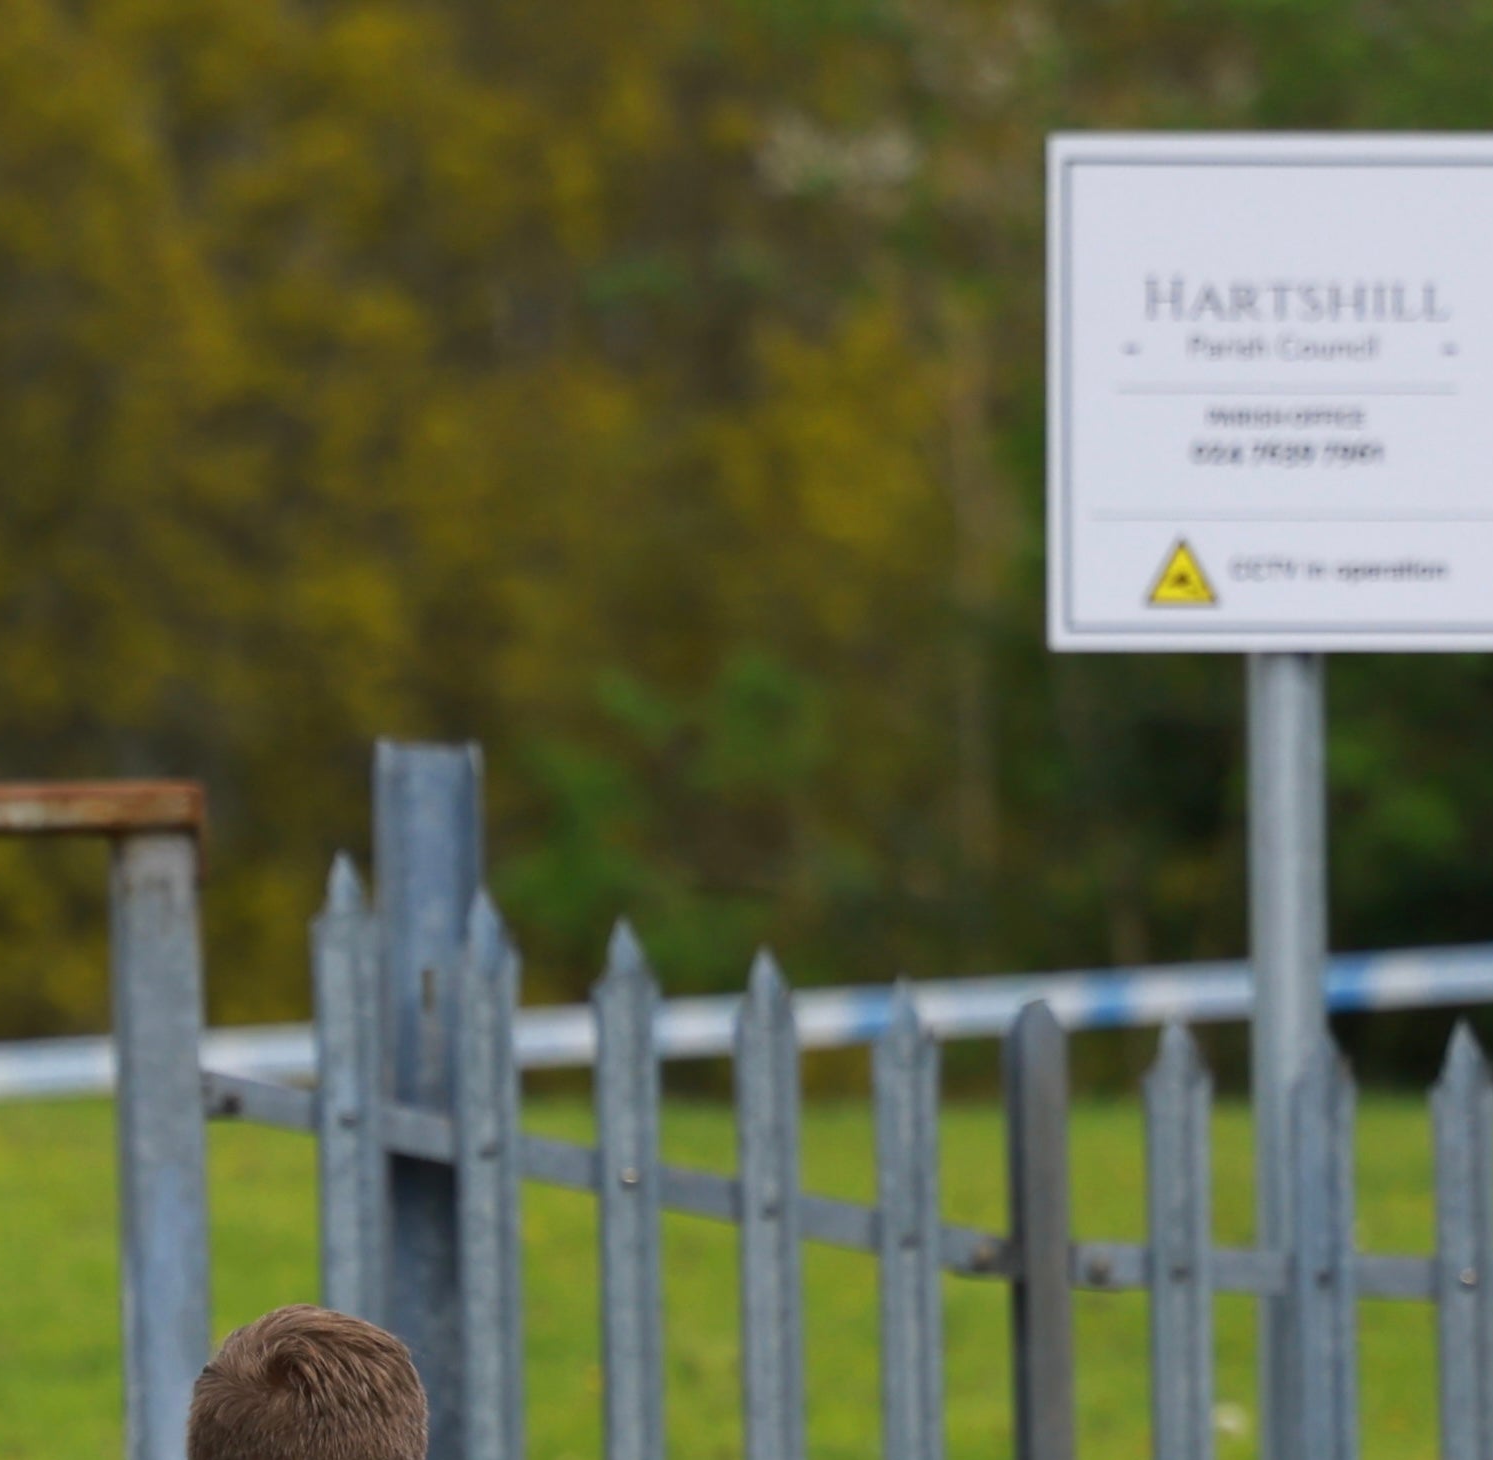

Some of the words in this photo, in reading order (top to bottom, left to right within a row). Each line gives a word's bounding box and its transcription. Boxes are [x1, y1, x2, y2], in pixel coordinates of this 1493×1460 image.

[1187, 333, 1269, 361] Parish
[1274, 335, 1380, 361] Council
[1227, 555, 1300, 582] CCTV
[1304, 560, 1329, 580] in
[1335, 560, 1448, 583] operation
